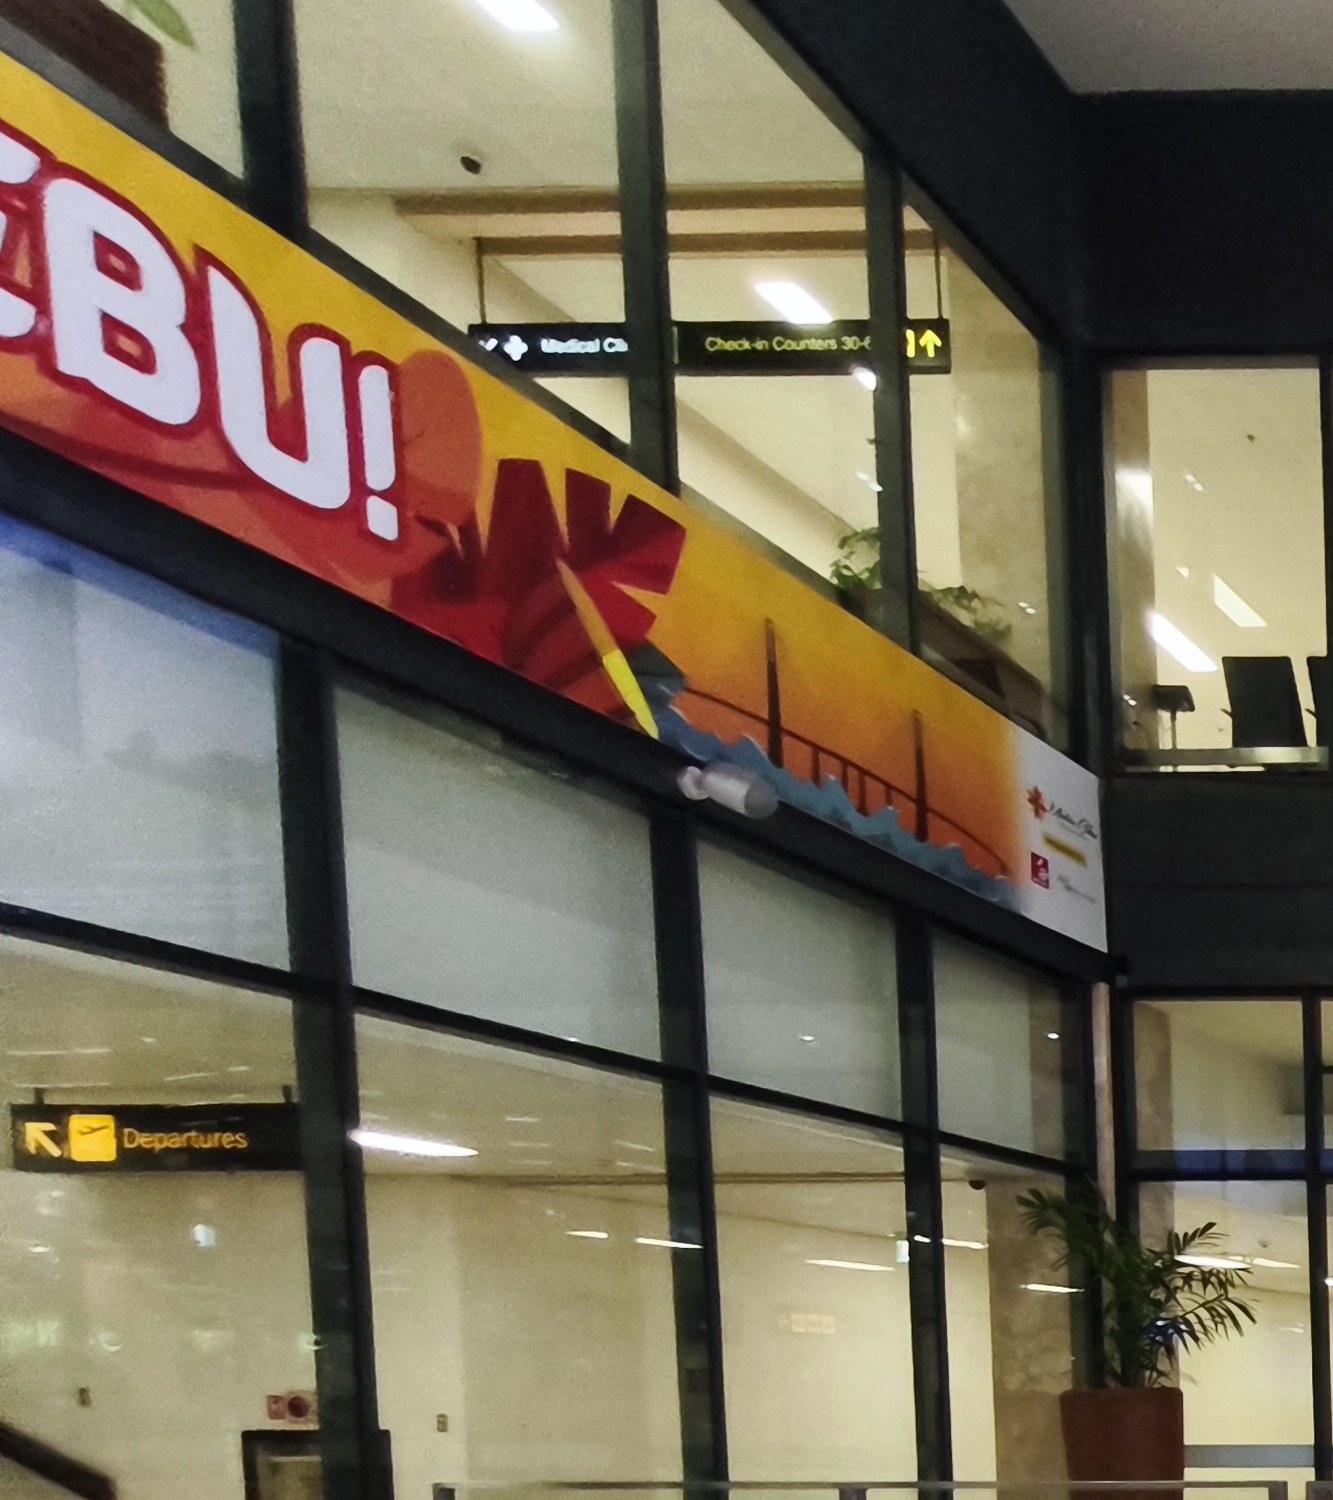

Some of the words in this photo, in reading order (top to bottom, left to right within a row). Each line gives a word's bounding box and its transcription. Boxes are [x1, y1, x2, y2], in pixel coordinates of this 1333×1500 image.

[705, 336, 769, 351] Check-in
[772, 336, 838, 351] Counters
[123, 1127, 248, 1153] Departures
